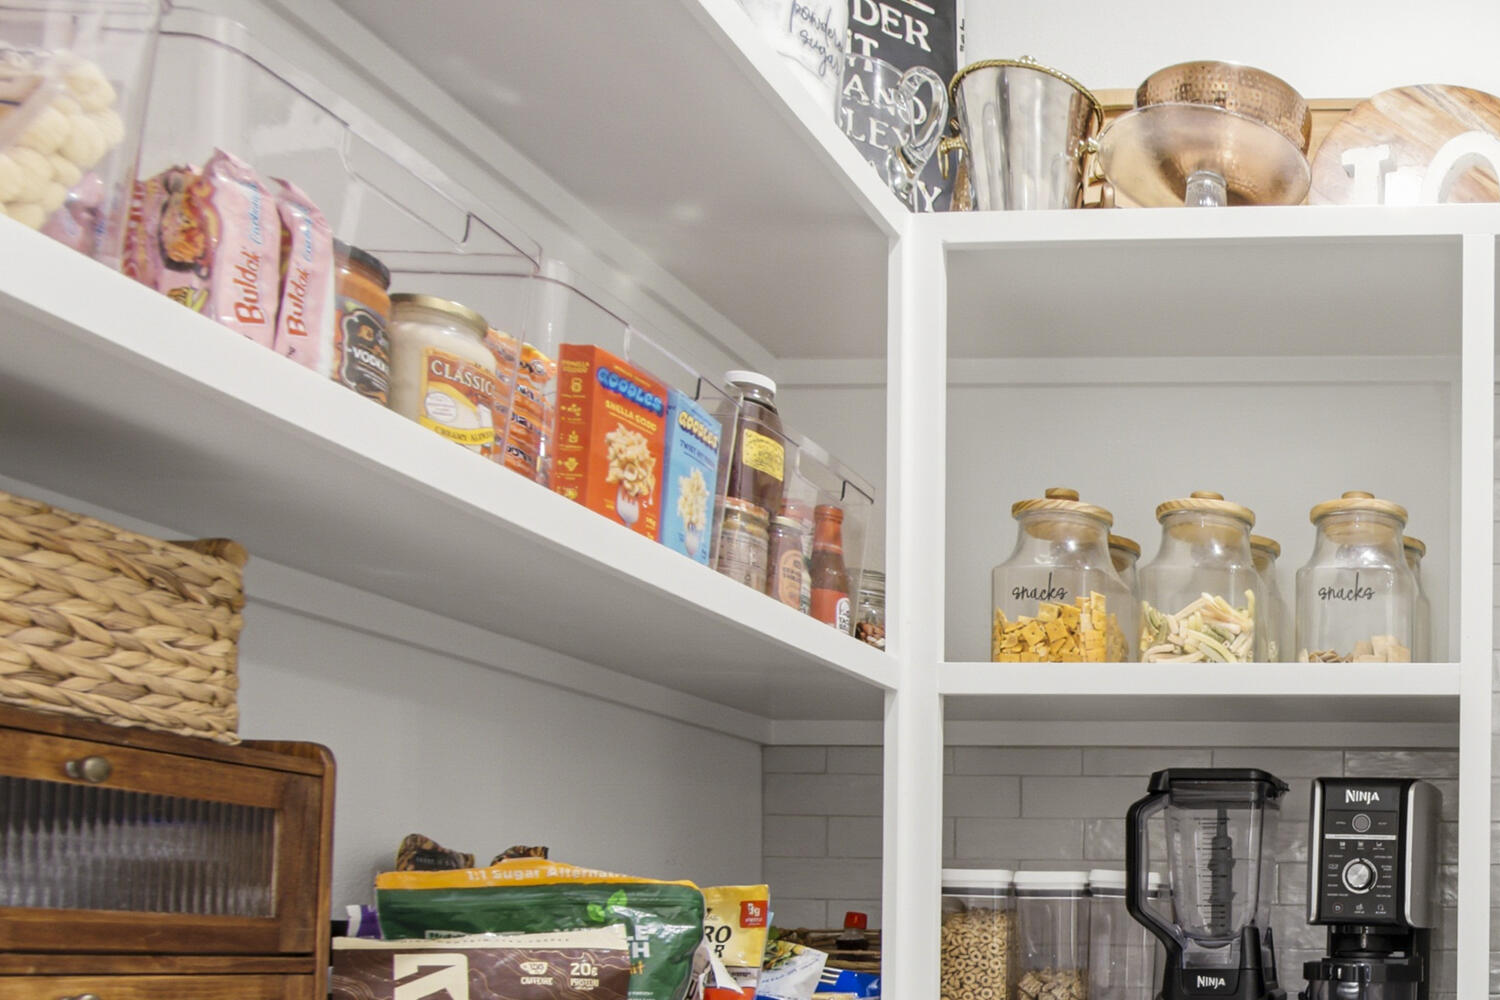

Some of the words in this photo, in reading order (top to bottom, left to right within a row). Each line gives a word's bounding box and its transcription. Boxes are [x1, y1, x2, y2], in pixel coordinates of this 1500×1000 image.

[233, 250, 266, 325] Buldak
[286, 267, 311, 337] Buldak
[431, 359, 496, 396] CLASSIC
[597, 366, 664, 417] GOODLES
[1011, 572, 1068, 600] snacks
[1317, 572, 1375, 600] snacks
[1345, 789, 1380, 805] NINJA
[466, 869, 487, 881] 1:1
[491, 868, 541, 882] Sugar
[545, 863, 628, 878] Alterna
[1196, 976, 1226, 989] NINJA
